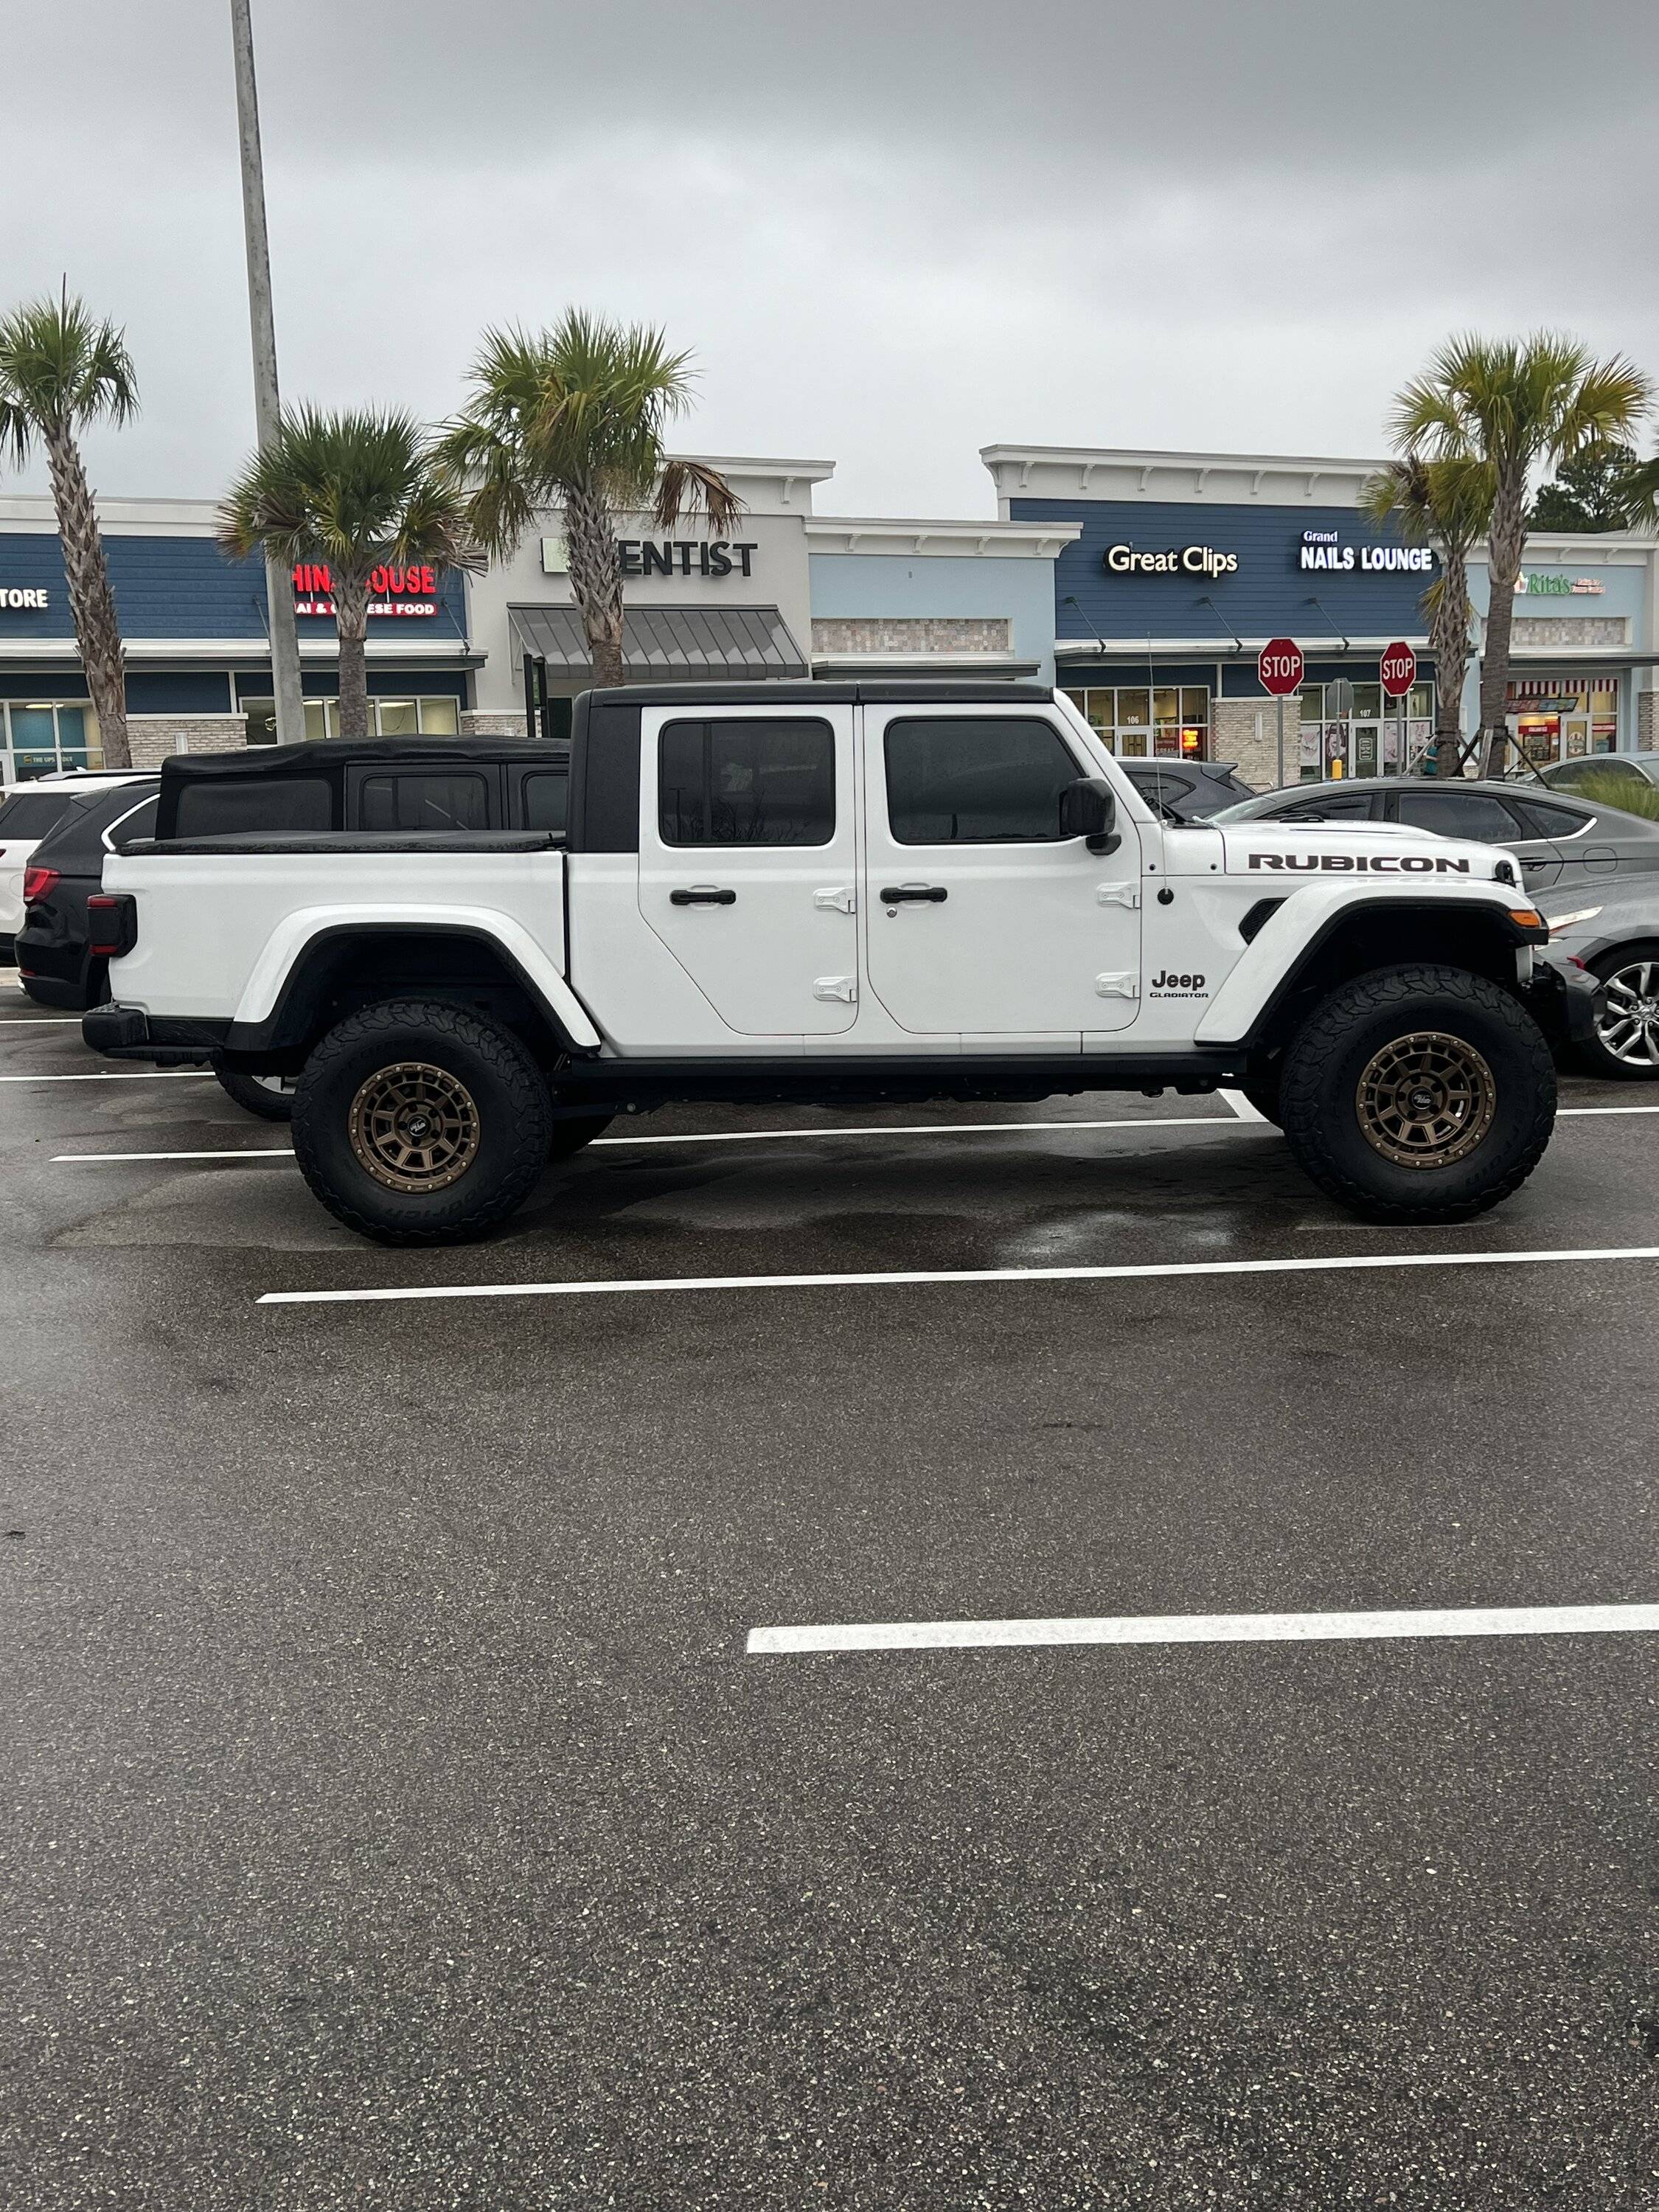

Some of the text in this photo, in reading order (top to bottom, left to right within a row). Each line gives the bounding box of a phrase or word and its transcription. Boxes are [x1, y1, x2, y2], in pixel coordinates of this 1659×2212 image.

[1304, 530, 1338, 542] Grand
[618, 540, 758, 577] ENTIST
[1108, 545, 1238, 578] Great Clips
[1301, 546, 1432, 571] NAILS LOUNGE
[291, 564, 437, 594] HIN OUSE
[1529, 573, 1571, 594] Rita's
[396, 603, 435, 614] FOOD
[1262, 655, 1301, 678] STOP
[1382, 658, 1413, 680] STOP
[1127, 716, 1139, 724] 106
[1360, 709, 1371, 717] 107
[1248, 854, 1470, 872] RUBICON
[1152, 970, 1206, 991] Jeep
